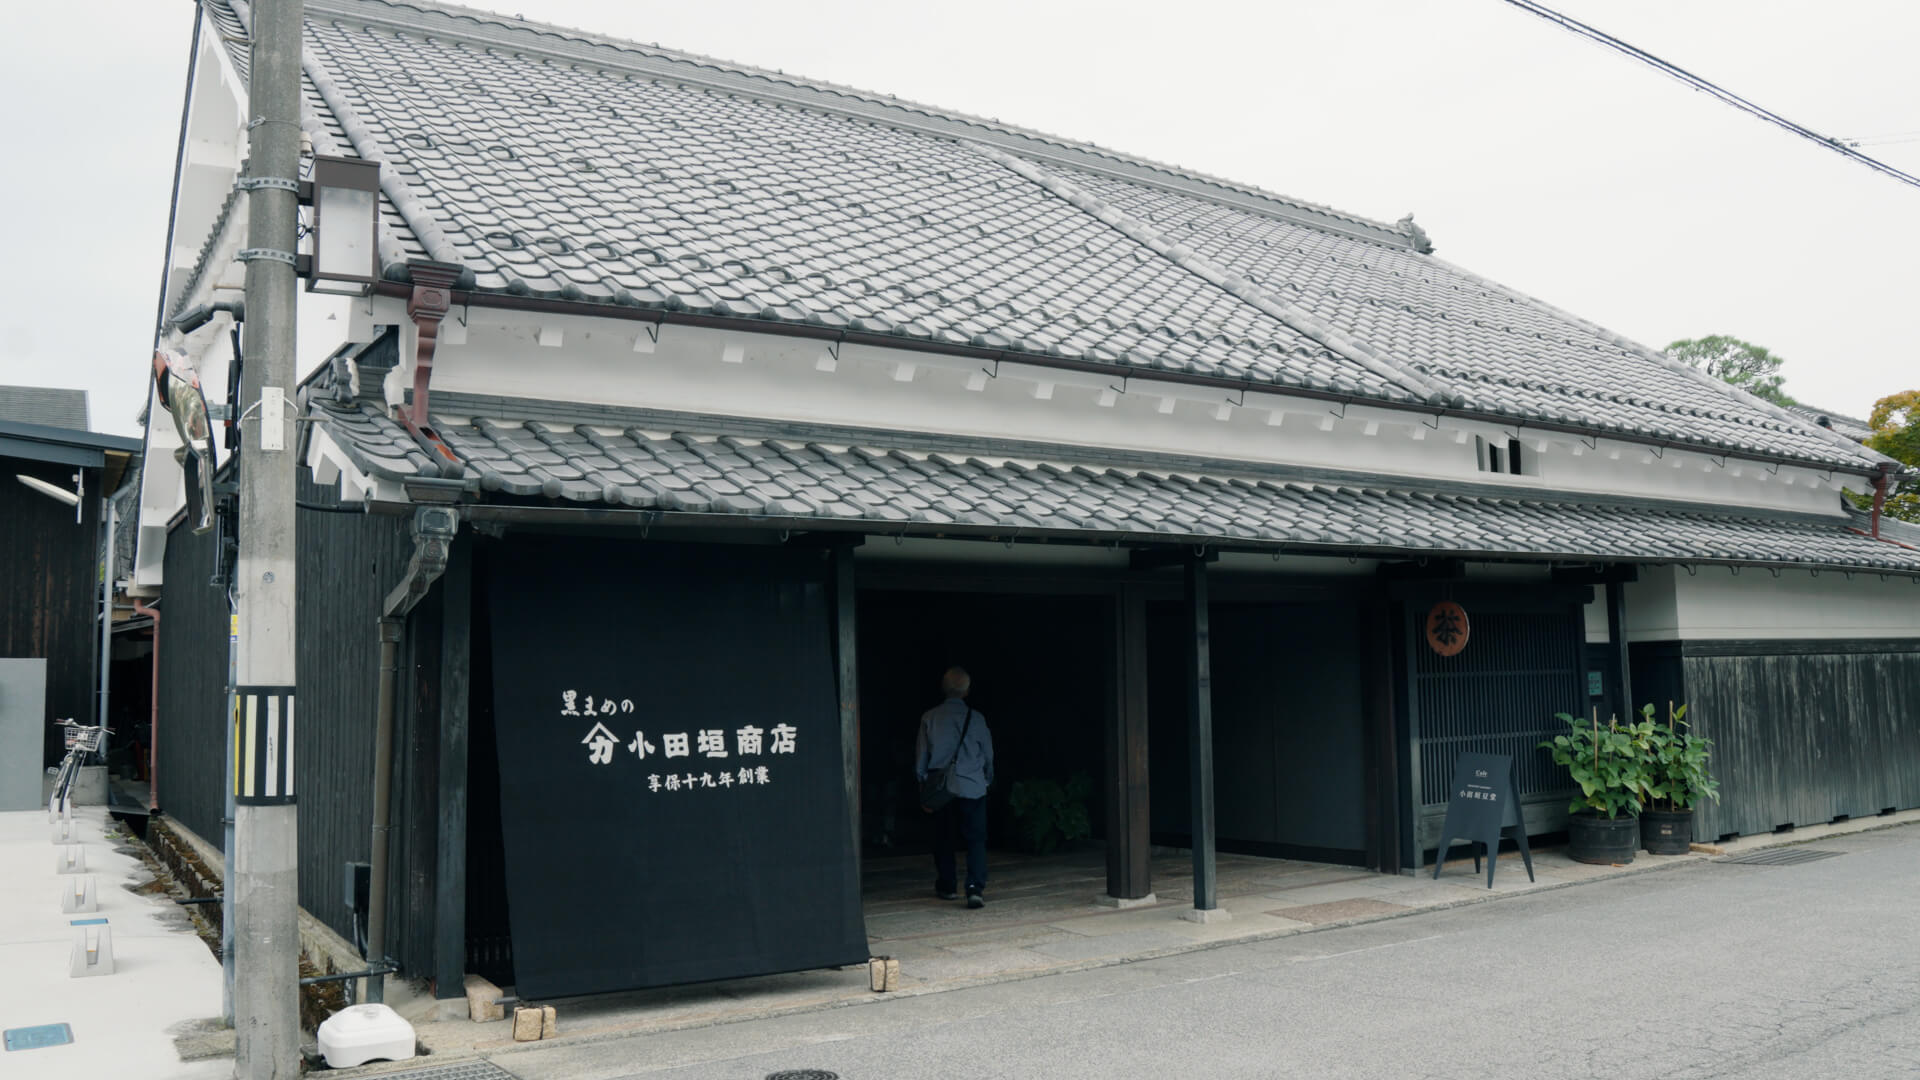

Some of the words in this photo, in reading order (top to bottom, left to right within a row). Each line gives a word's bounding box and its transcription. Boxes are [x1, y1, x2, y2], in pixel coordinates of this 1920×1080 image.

[561, 690, 635, 716] 黒まめの
[628, 723, 797, 760] 小田垣商店
[648, 766, 771, 793] 享保十九年創業
